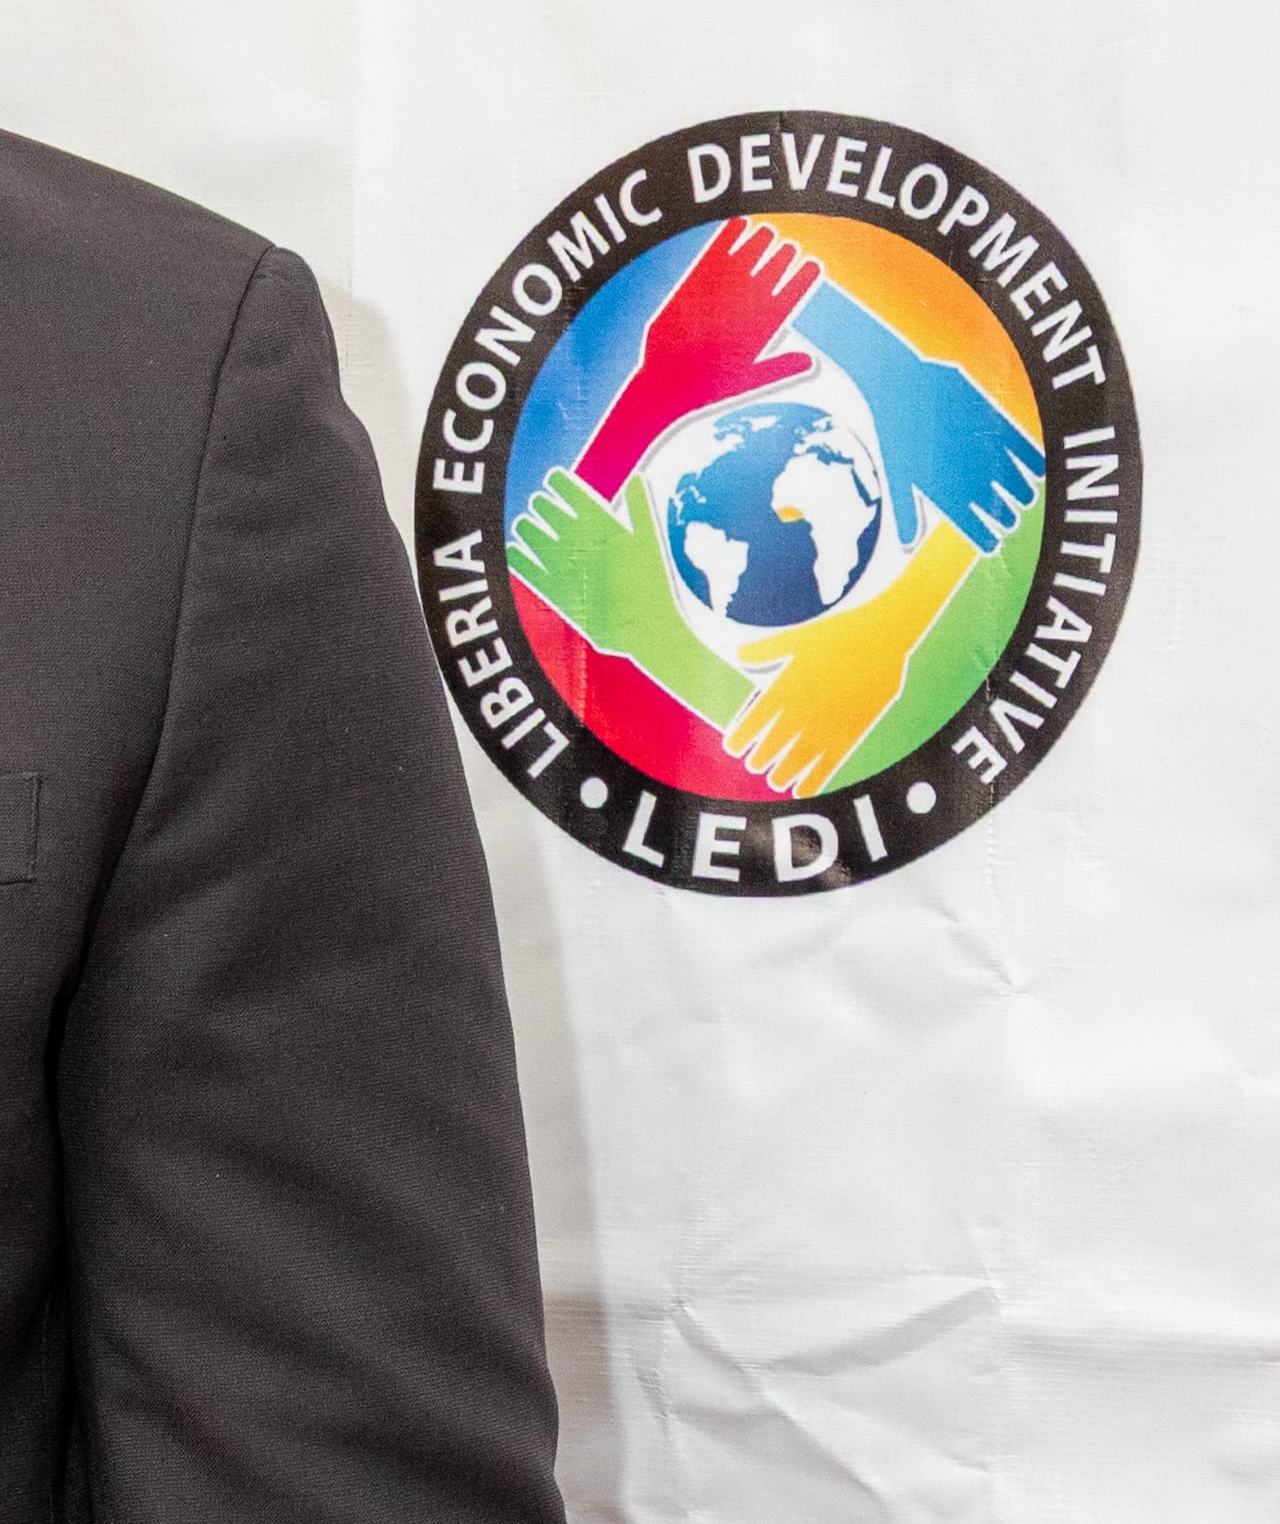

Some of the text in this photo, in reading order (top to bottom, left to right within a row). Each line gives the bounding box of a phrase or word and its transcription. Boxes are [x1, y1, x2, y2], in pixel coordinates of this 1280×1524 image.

[431, 132, 1120, 785] LIBERIA ECONOMIC DEVELOPMENT INITIATIVE
[622, 794, 887, 882] LEDI
